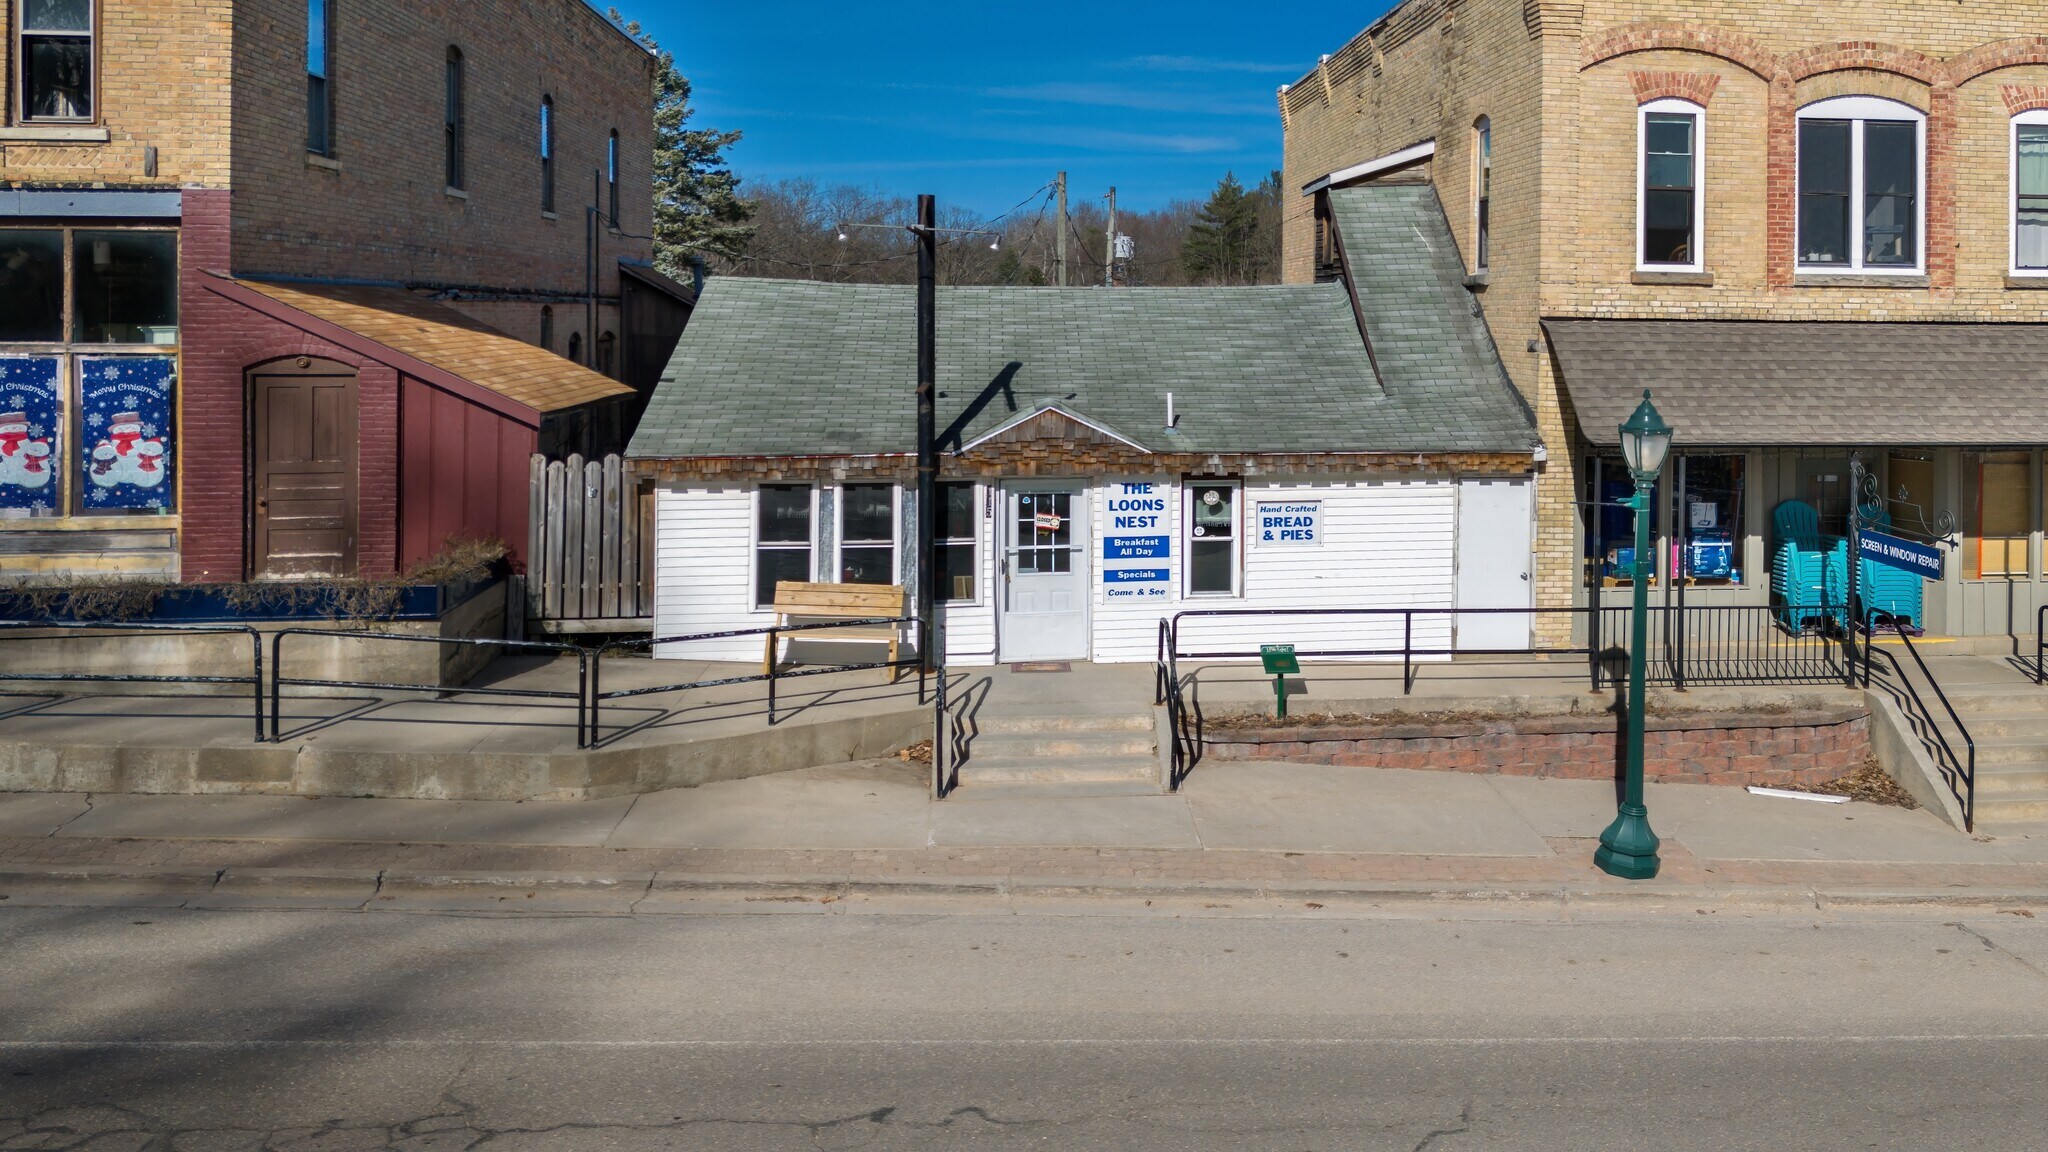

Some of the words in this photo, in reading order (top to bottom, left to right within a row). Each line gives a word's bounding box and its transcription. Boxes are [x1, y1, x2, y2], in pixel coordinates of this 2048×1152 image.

[5, 383, 49, 399] Christmas
[88, 386, 117, 400] Merry
[117, 383, 161, 399] Christmas
[1121, 483, 1153, 495] THE
[1108, 499, 1165, 512] LOONS
[1259, 505, 1282, 513] Hand
[1285, 505, 1318, 513] Crafted
[1115, 516, 1159, 528] NEST
[1263, 516, 1313, 528] BREAD
[1262, 529, 1275, 541] &
[1280, 529, 1314, 541] PIES
[1114, 538, 1159, 547] Breakfast
[1120, 548, 1132, 556] All
[1136, 548, 1153, 557] Day
[1861, 537, 1883, 554] SCREEN
[1883, 544, 1889, 556] &
[1889, 545, 1917, 564] WINDOW
[1917, 554, 1940, 570] REPAIR
[1117, 571, 1156, 580] Specials
[1108, 589, 1134, 597] Come
[1137, 588, 1145, 596] &
[1149, 588, 1166, 596] See
